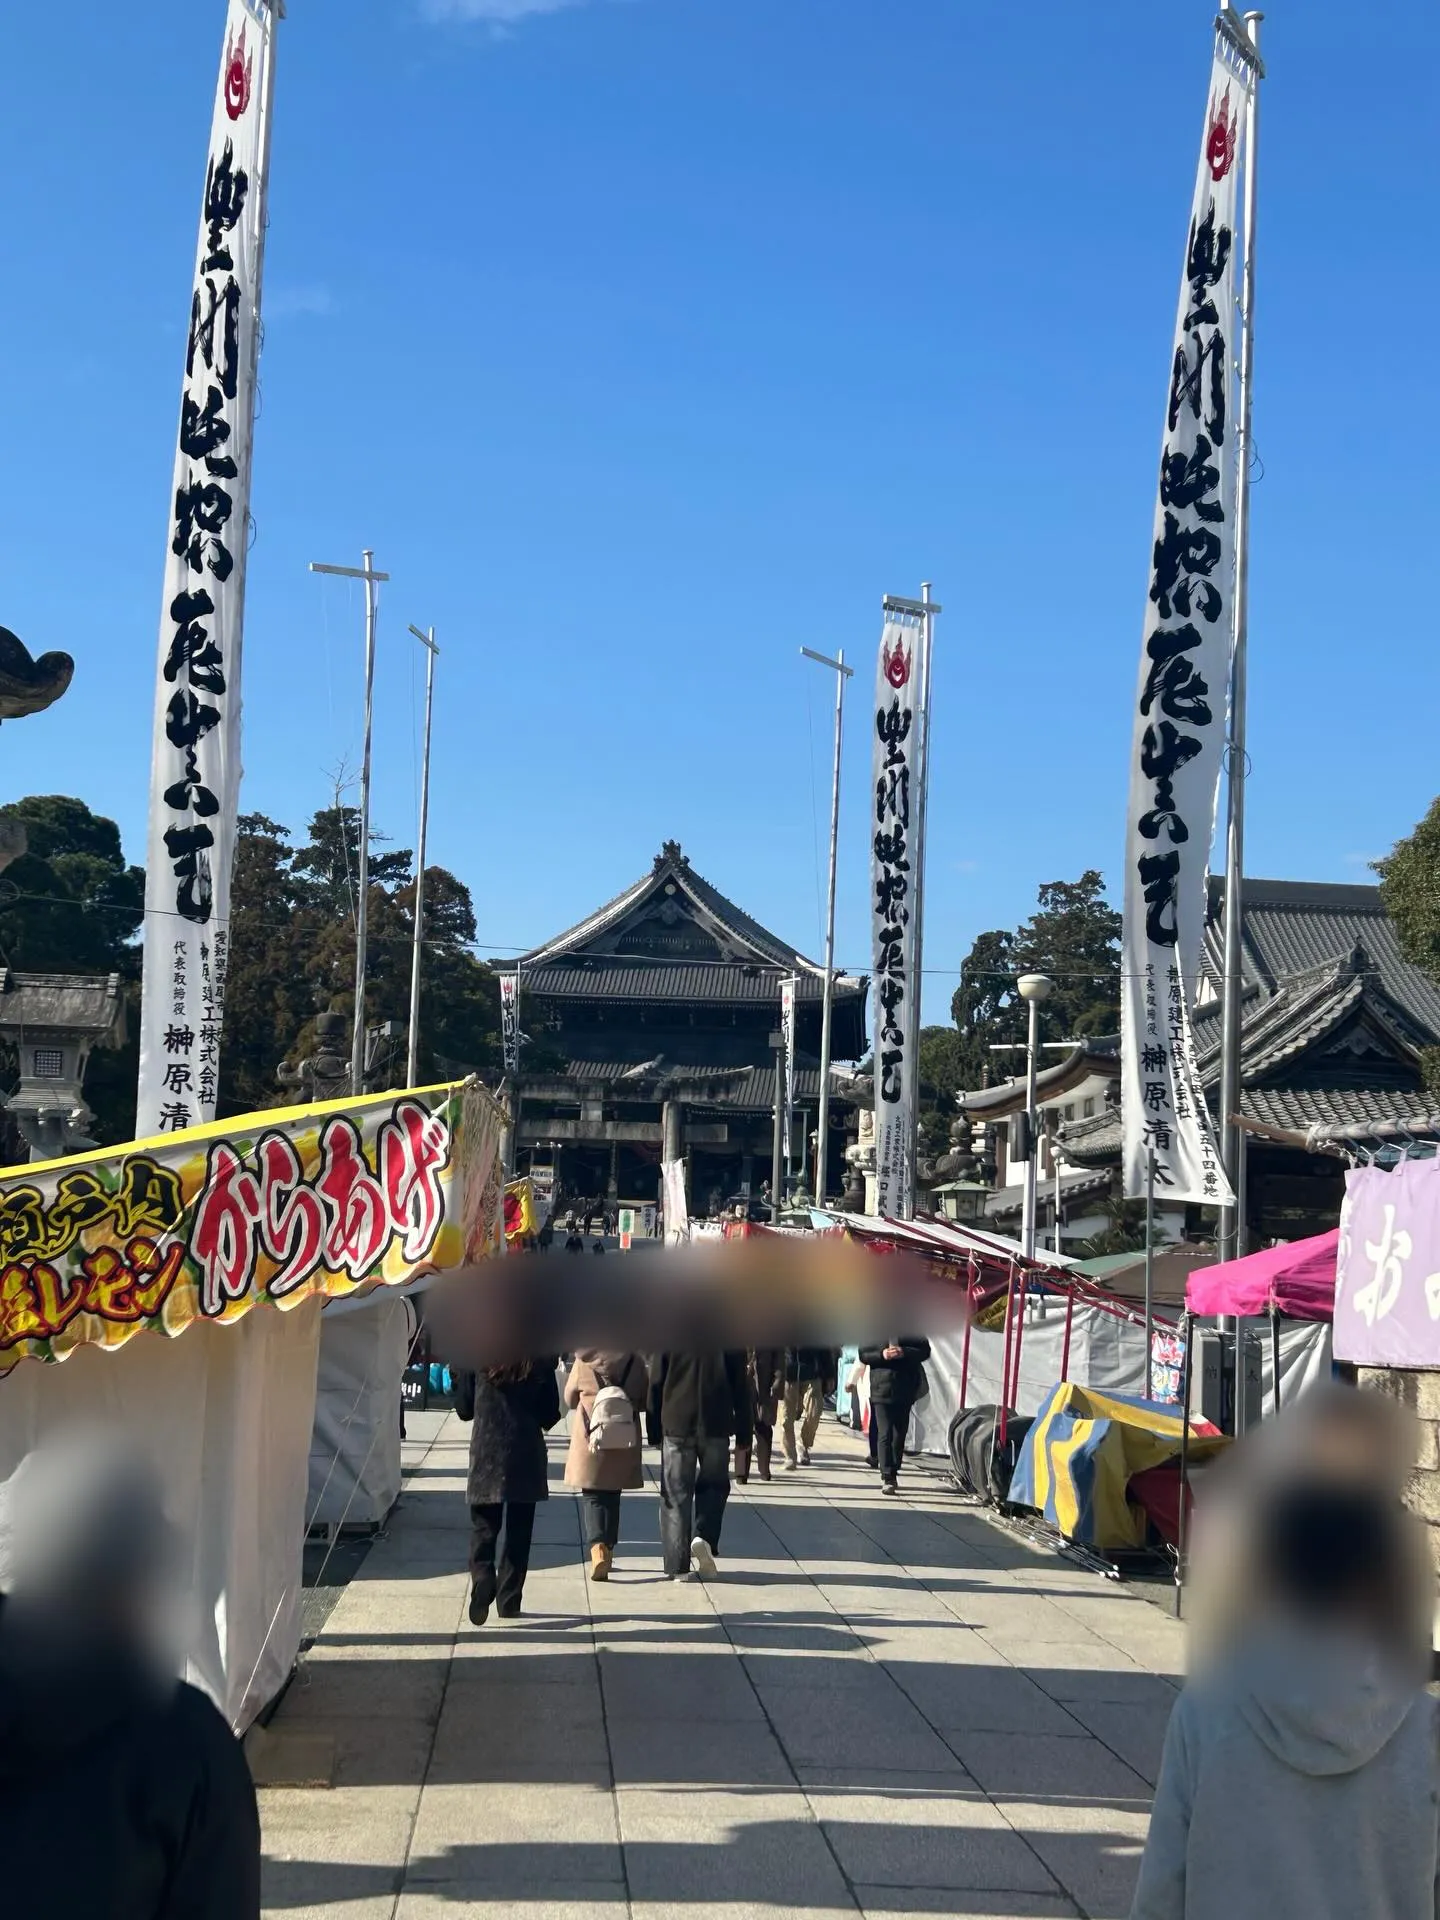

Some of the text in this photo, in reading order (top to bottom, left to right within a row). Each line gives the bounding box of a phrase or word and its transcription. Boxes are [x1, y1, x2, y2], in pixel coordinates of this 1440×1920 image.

[172, 940, 188, 1017] 代表取締役
[1141, 1043, 1175, 1186] 榊原清太
[187, 1098, 452, 1317] からあげ
[1353, 1204, 1440, 1328] お
